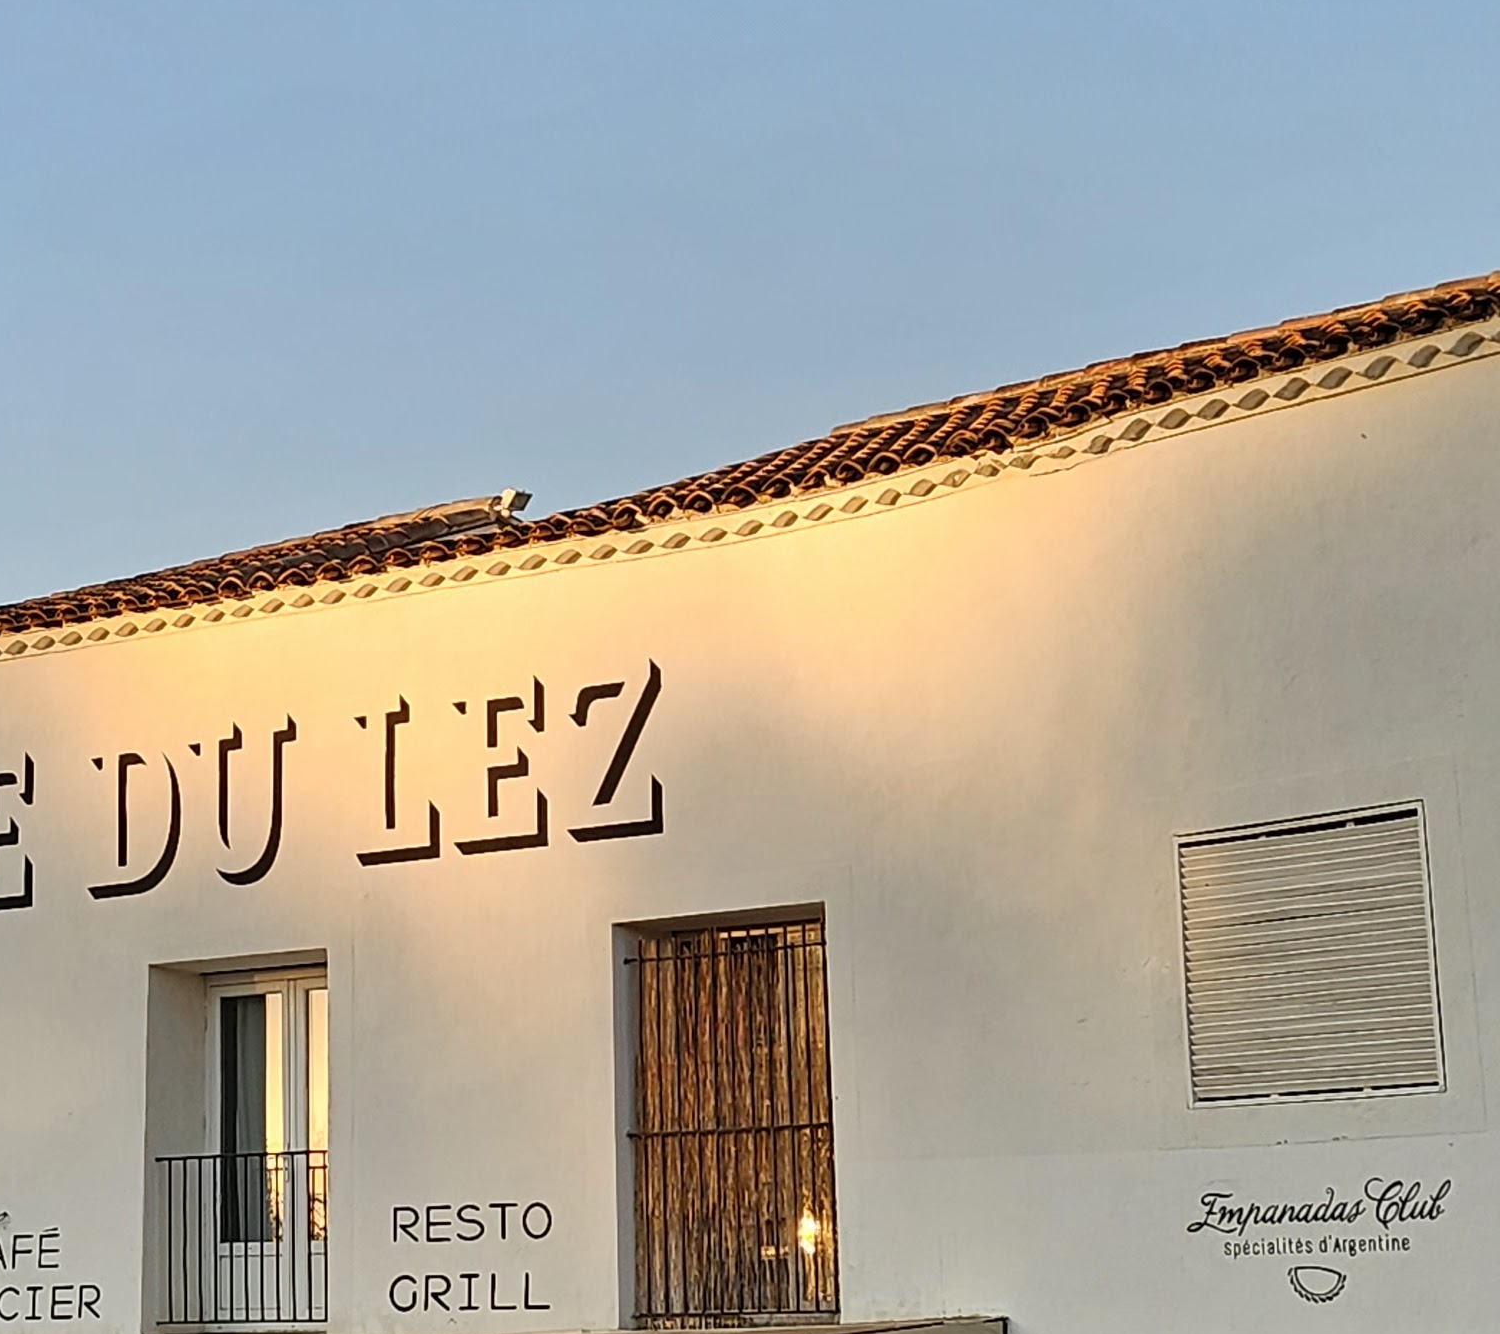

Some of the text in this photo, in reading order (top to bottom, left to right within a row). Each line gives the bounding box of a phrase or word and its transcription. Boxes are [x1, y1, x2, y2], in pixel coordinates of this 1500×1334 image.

[88, 712, 296, 900] DU
[356, 657, 665, 867] LEZ
[392, 1201, 553, 1243] RESTO
[1186, 1176, 1452, 1237] Empanadas Club
[1318, 1233, 1411, 1257] d'Argentine
[389, 1271, 551, 1313] GRILL
